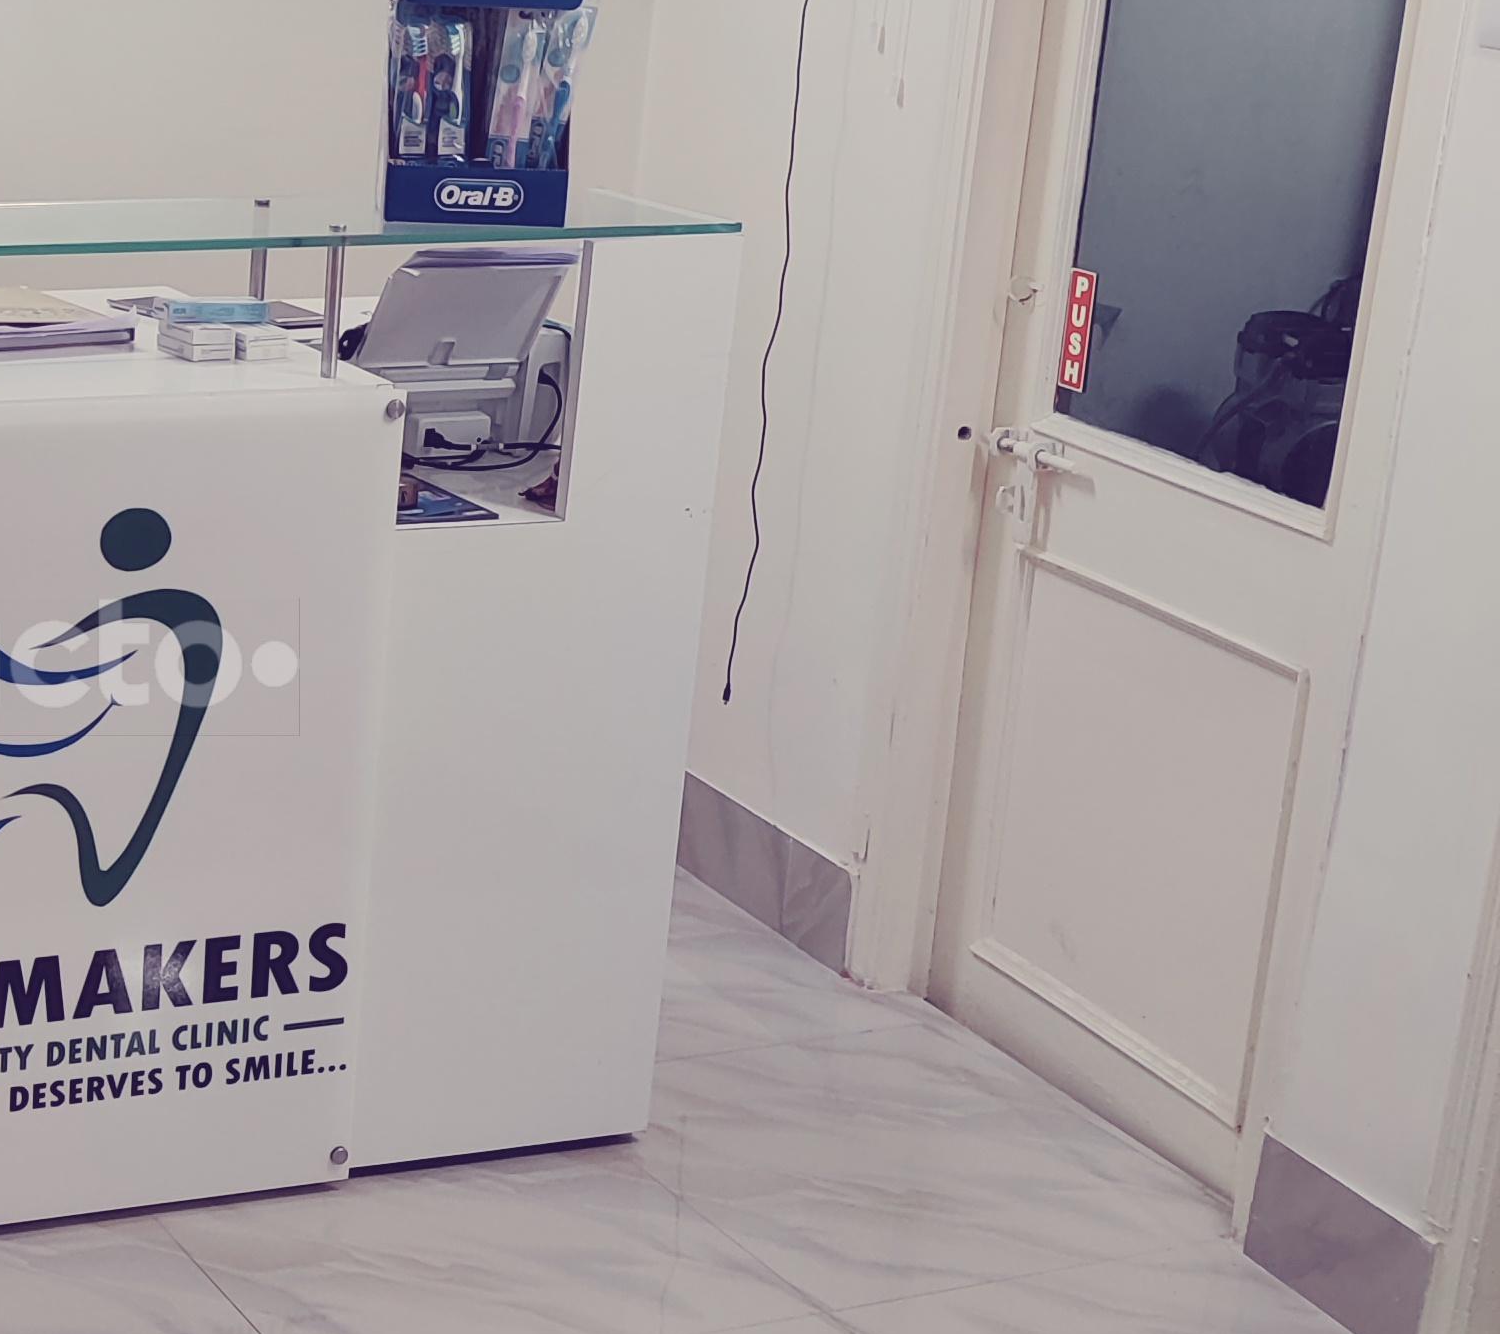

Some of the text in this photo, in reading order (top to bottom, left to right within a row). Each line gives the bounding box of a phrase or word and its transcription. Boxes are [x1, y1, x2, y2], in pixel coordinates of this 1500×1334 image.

[439, 184, 516, 208] Oral-B
[1063, 275, 1090, 385] PUSH
[46, 1028, 161, 1068] DENTAL
[171, 1015, 270, 1052] CLINIC
[9, 1068, 164, 1113] DESERVES
[175, 1062, 213, 1091] TO
[225, 1049, 348, 1085] SMILE...
